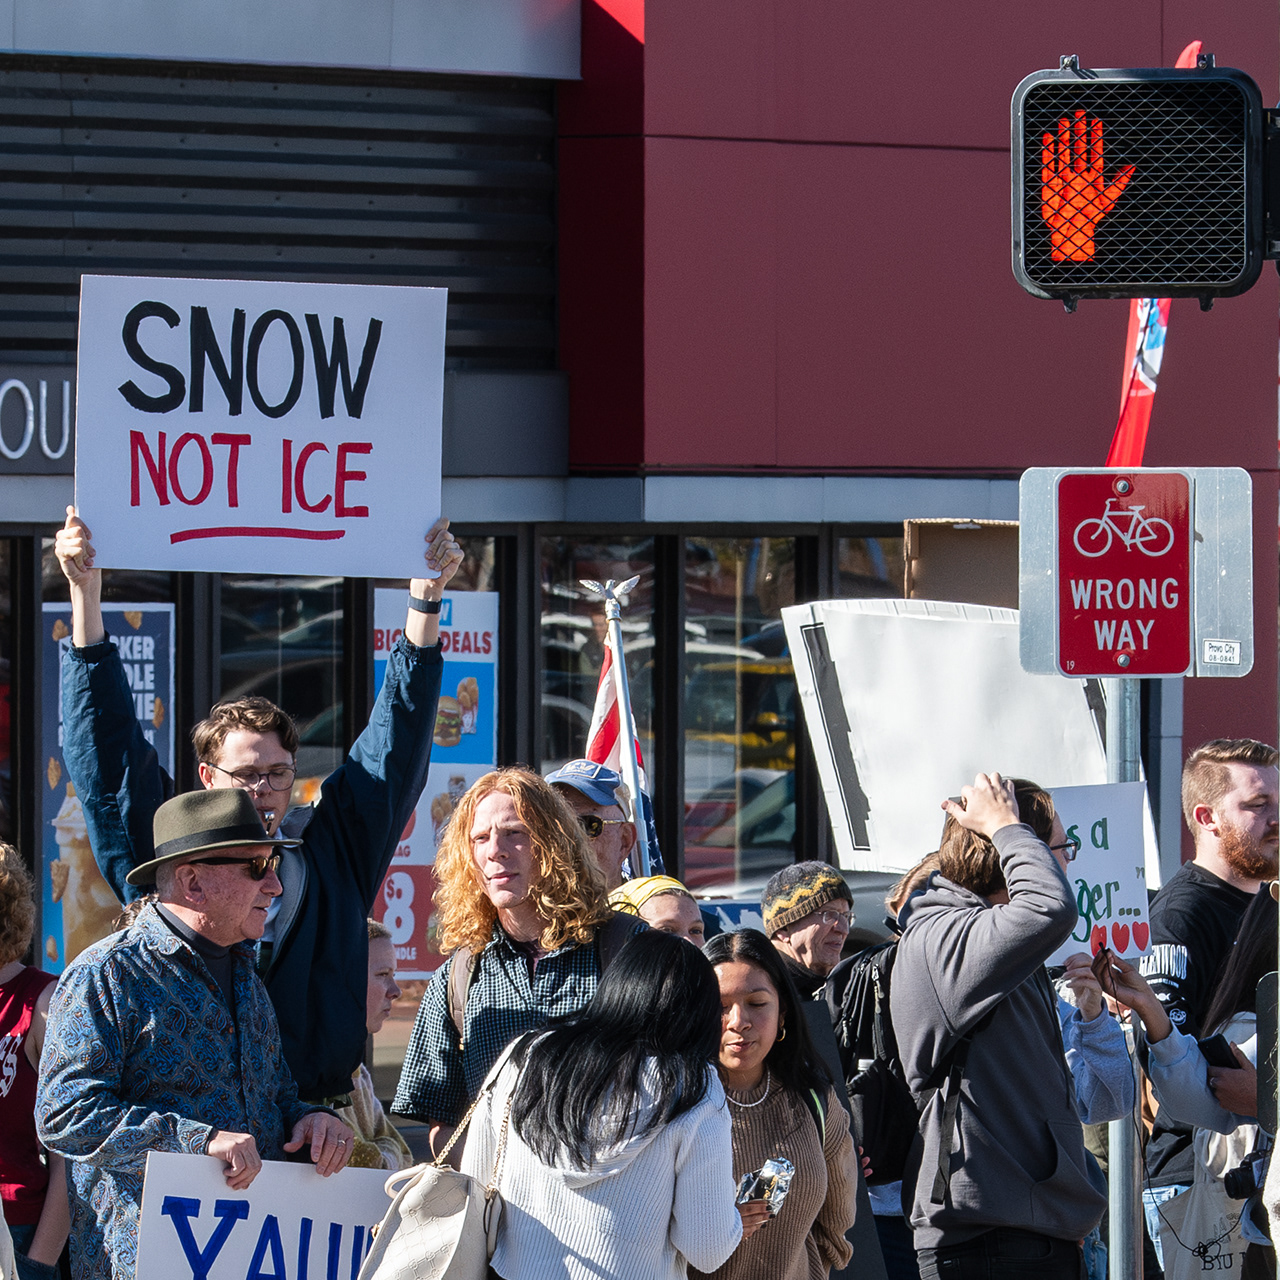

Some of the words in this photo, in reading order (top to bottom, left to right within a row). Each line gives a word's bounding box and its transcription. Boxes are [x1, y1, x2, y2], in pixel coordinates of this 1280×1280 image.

[118, 300, 383, 419] SNOW
[130, 430, 251, 508] NOT
[282, 437, 373, 518] ICE
[1071, 577, 1179, 610] WRONG
[440, 631, 492, 655] DEALS
[1094, 619, 1155, 650] WAY
[1208, 642, 1223, 653] Provo
[1224, 643, 1235, 655] City
[1066, 660, 1075, 671] 19
